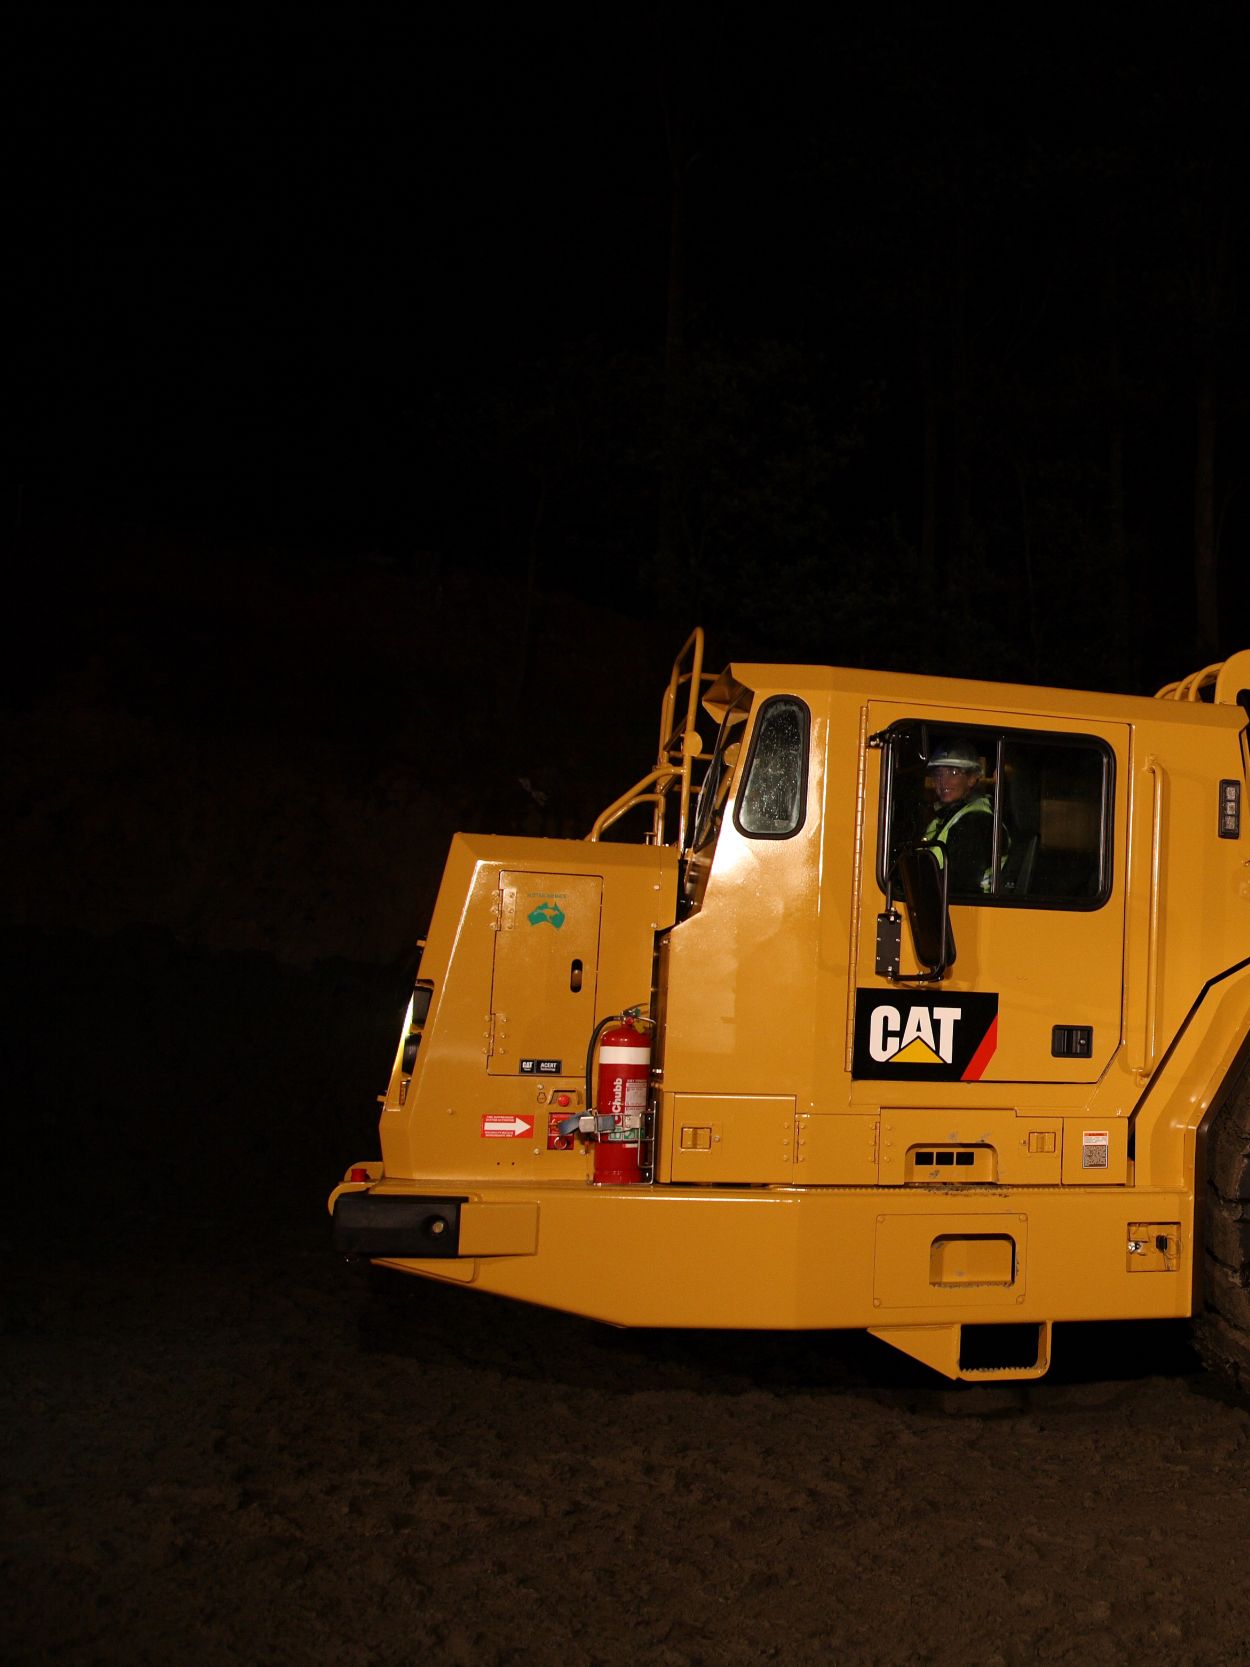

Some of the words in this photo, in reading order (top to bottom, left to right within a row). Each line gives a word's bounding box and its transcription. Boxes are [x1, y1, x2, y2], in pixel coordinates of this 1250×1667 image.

[869, 1005, 962, 1064] CAT
[522, 1061, 533, 1069] CAT
[612, 1077, 623, 1113] Chubb
